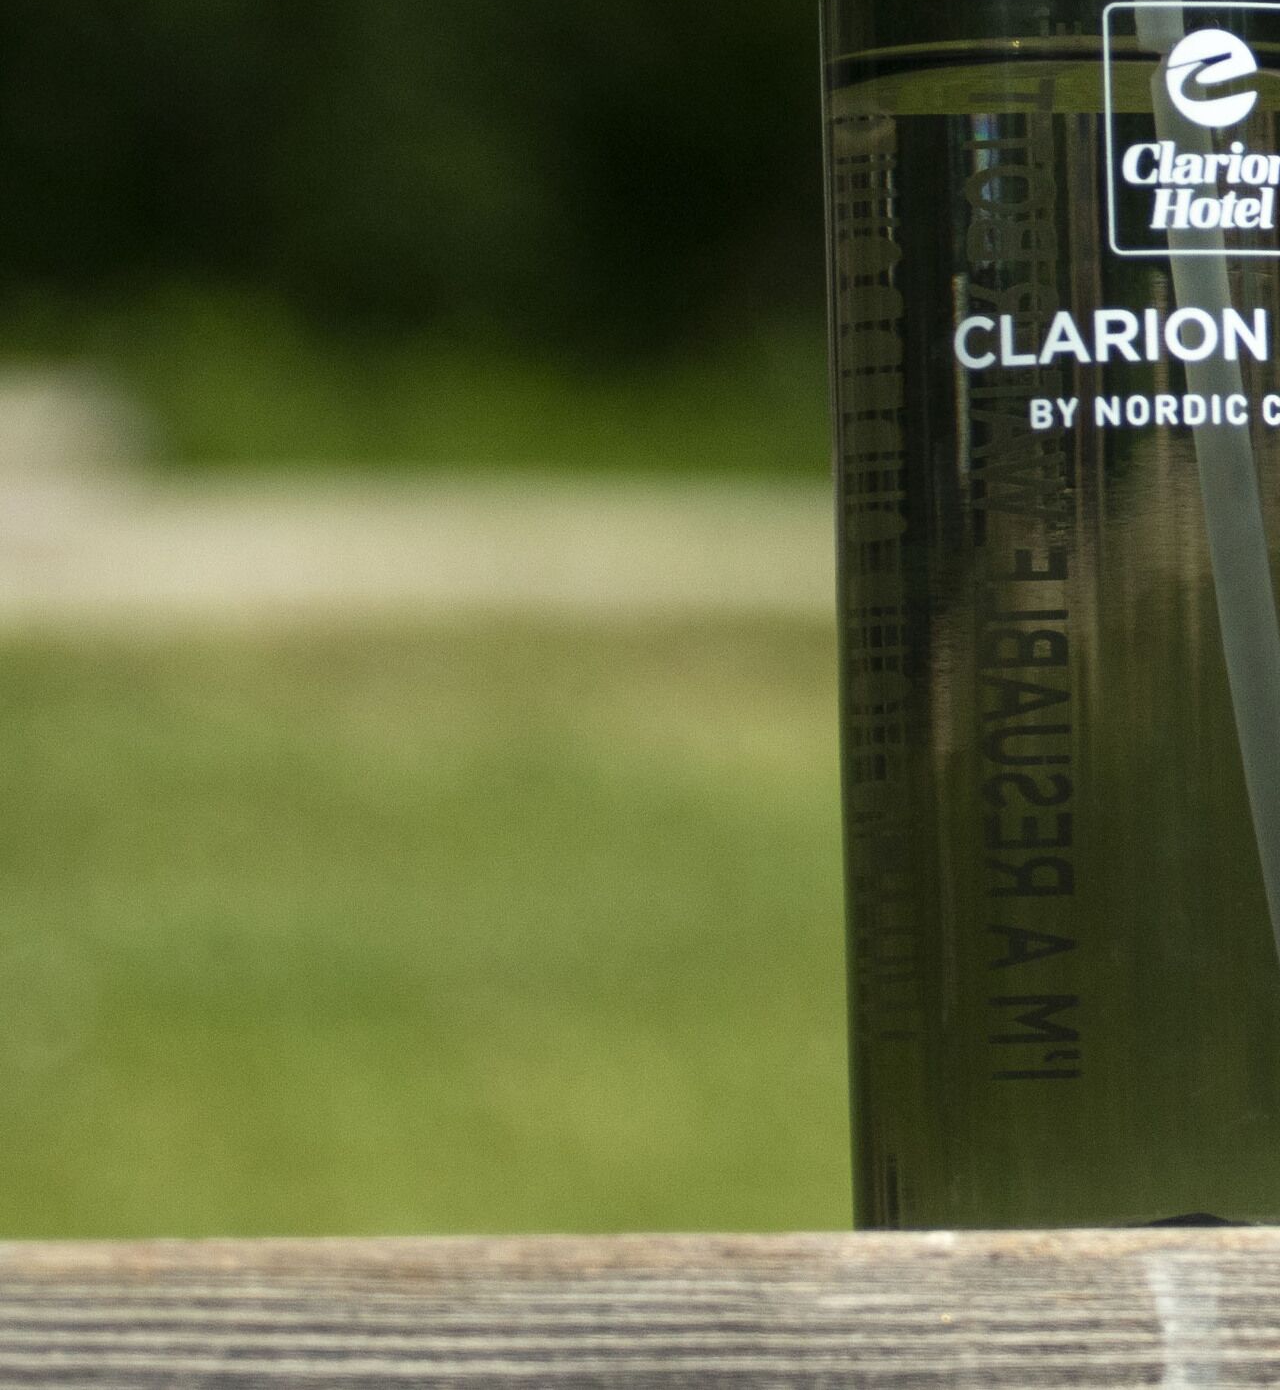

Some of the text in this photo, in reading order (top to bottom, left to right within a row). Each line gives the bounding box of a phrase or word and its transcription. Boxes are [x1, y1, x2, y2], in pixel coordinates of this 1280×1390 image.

[1149, 187, 1275, 230] Hotel
[954, 307, 1268, 370] CLARION
[1030, 397, 1079, 430] BY
[1094, 391, 1249, 428] NORDIC
